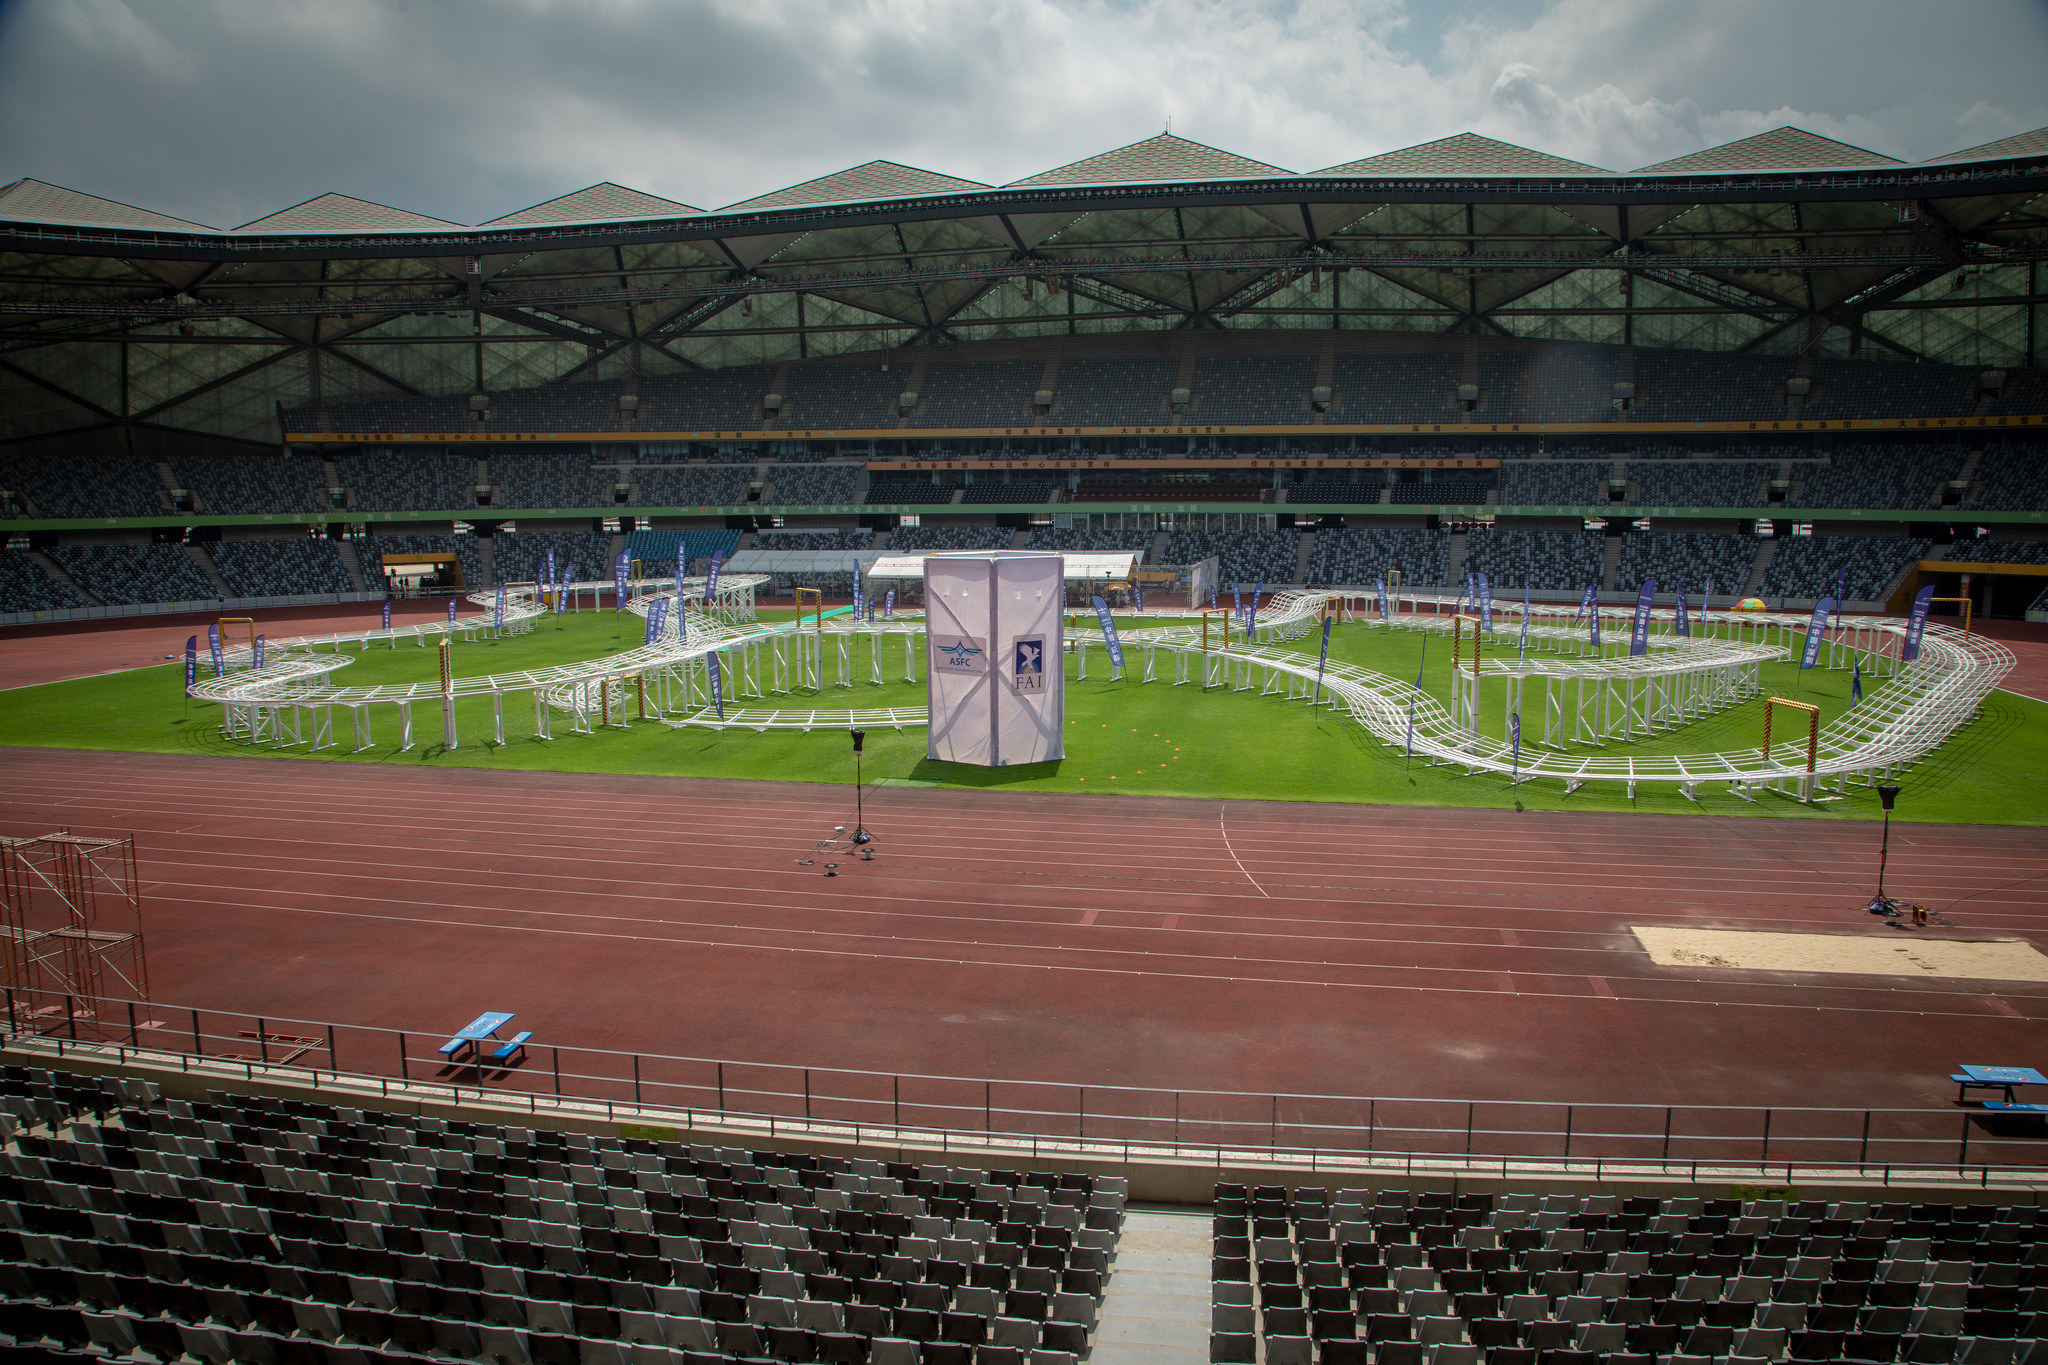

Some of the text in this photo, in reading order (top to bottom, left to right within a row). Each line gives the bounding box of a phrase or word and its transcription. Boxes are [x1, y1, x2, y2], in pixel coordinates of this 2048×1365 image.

[1749, 420, 1851, 430] 佳兆业集团
[1005, 426, 1226, 436] 佳兆业集团 大运中心总运营商
[901, 461, 1110, 470] 佳兆业集团 大运中心总运营商
[1251, 460, 1483, 468] 佳兆业集团 大运中心总运营商
[949, 657, 971, 667] ASFC
[1016, 675, 1042, 690] FAI
